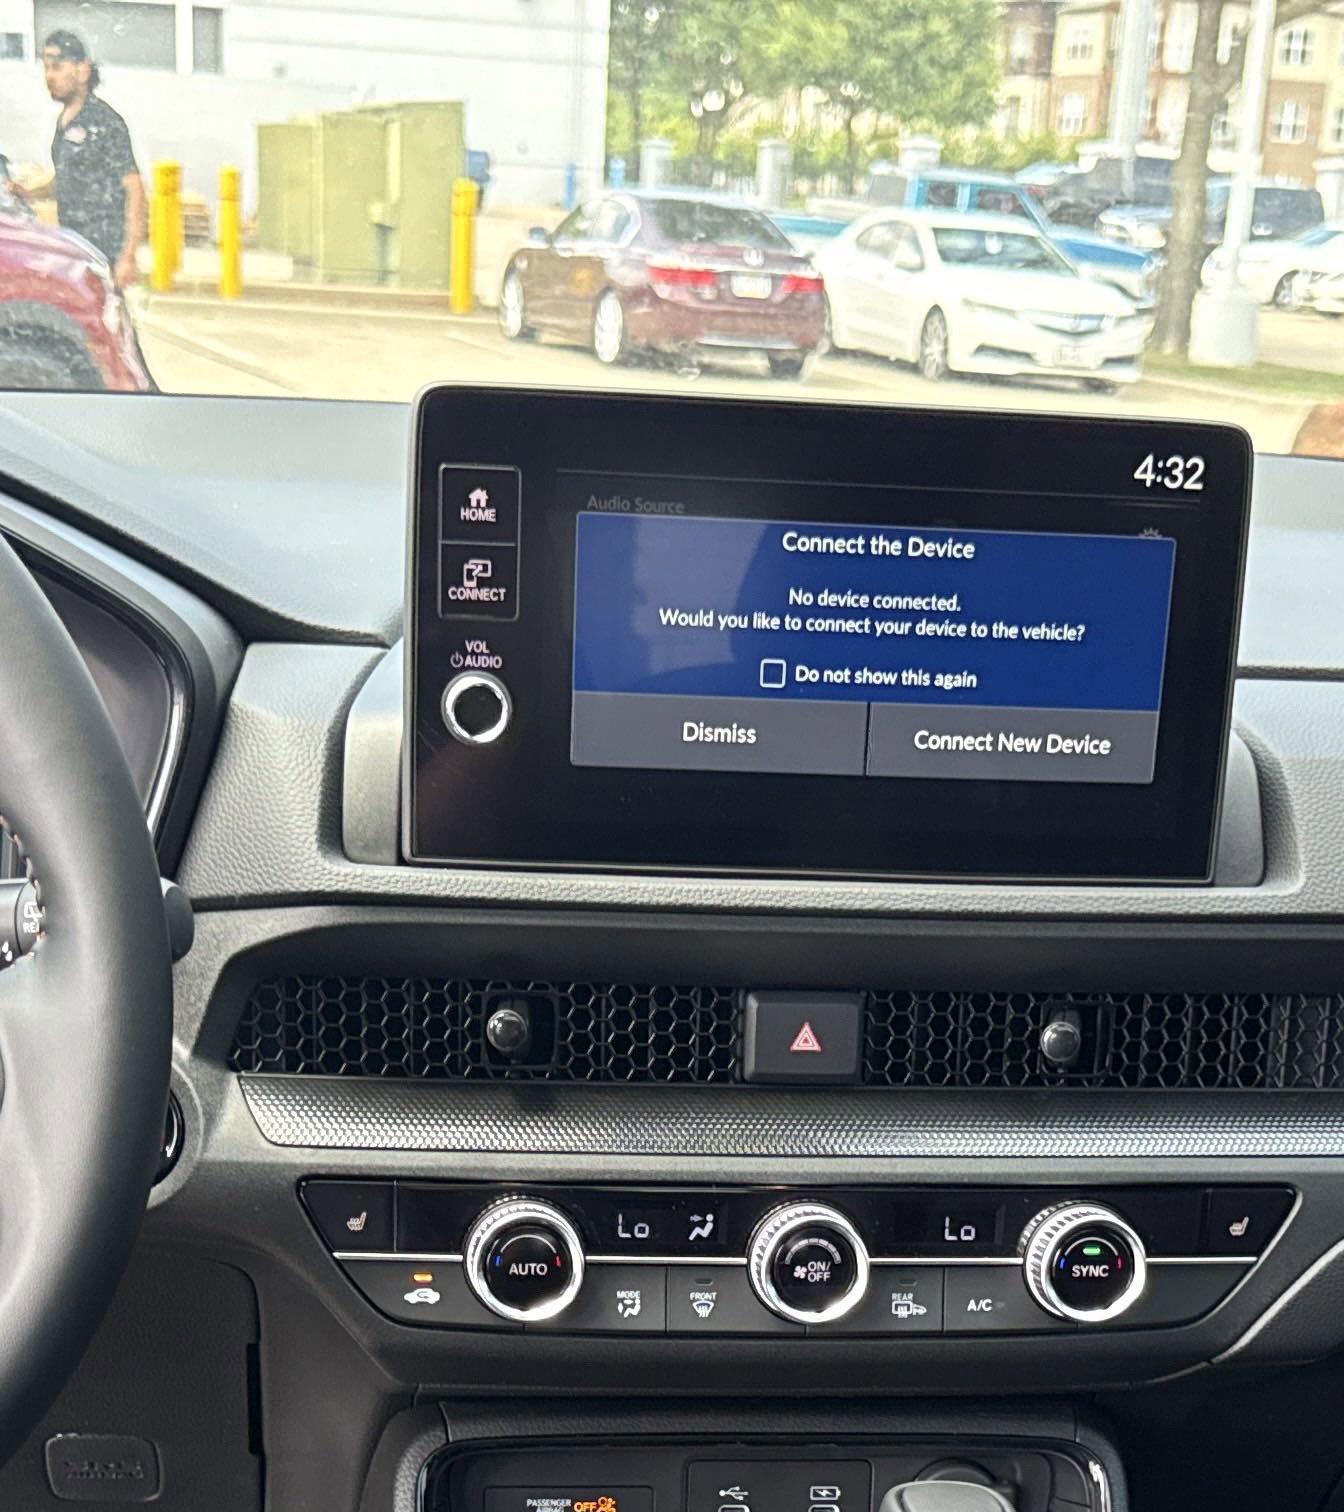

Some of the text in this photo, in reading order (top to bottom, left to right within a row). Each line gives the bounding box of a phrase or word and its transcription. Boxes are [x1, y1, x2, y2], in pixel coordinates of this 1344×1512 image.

[1133, 454, 1205, 490] 4:32
[586, 496, 685, 515] Audio Source
[460, 507, 497, 522] HOME
[782, 531, 976, 560] Connect the Device
[448, 587, 506, 602] CONNECT
[789, 588, 962, 613] No device connected.
[659, 608, 1086, 642] Would you like to connect your device to the vehicle?
[465, 640, 490, 654] VOL
[464, 655, 503, 669] AUDIO
[795, 665, 978, 690] Do not show this again
[682, 721, 757, 744] Dismiss
[913, 730, 1112, 755] Connect New Device
[617, 1213, 650, 1239] Lo
[944, 1216, 976, 1241] Lo
[509, 1263, 548, 1276] AUTO
[807, 1262, 831, 1273] ON/
[1071, 1265, 1109, 1279] SYNC
[807, 1272, 831, 1283] OFF
[616, 1290, 641, 1300] MODE
[689, 1292, 717, 1301] FRONT
[891, 1293, 914, 1302] REAR
[967, 1298, 993, 1312] A/C
[526, 1498, 571, 1507] PASSENGER
[574, 1502, 597, 1512] OFF
